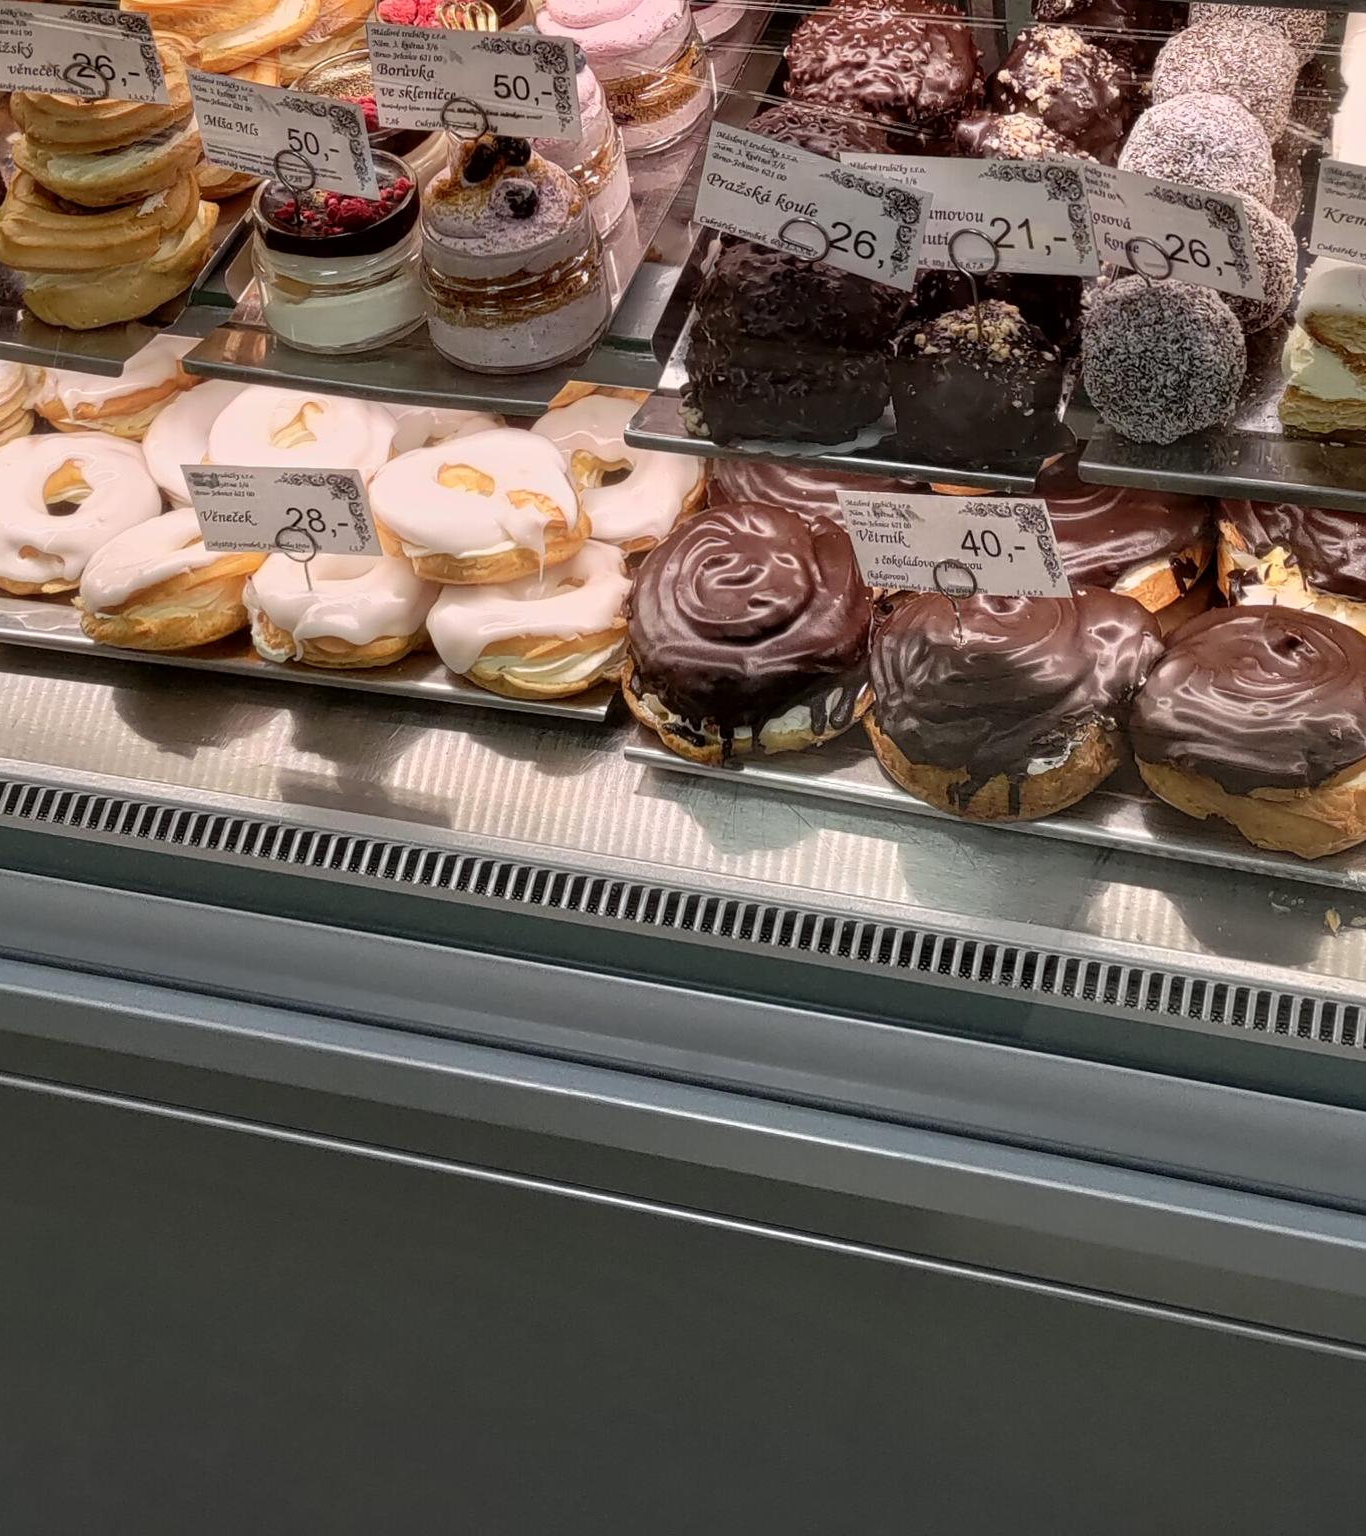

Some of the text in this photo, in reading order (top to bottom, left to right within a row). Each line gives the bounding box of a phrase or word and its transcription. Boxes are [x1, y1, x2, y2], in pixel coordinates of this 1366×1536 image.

[7, 52, 140, 87] věneček 26,-
[376, 63, 552, 106] Borůvka 50,-
[380, 85, 457, 102] ve skleničce
[287, 128, 339, 162] 50,-
[707, 172, 819, 218] Pražská koule
[990, 217, 1067, 255] 21,-
[1165, 233, 1235, 276] 26,-
[200, 507, 348, 537] Věneček 28,-
[856, 529, 1026, 563] Větrník 40,-
